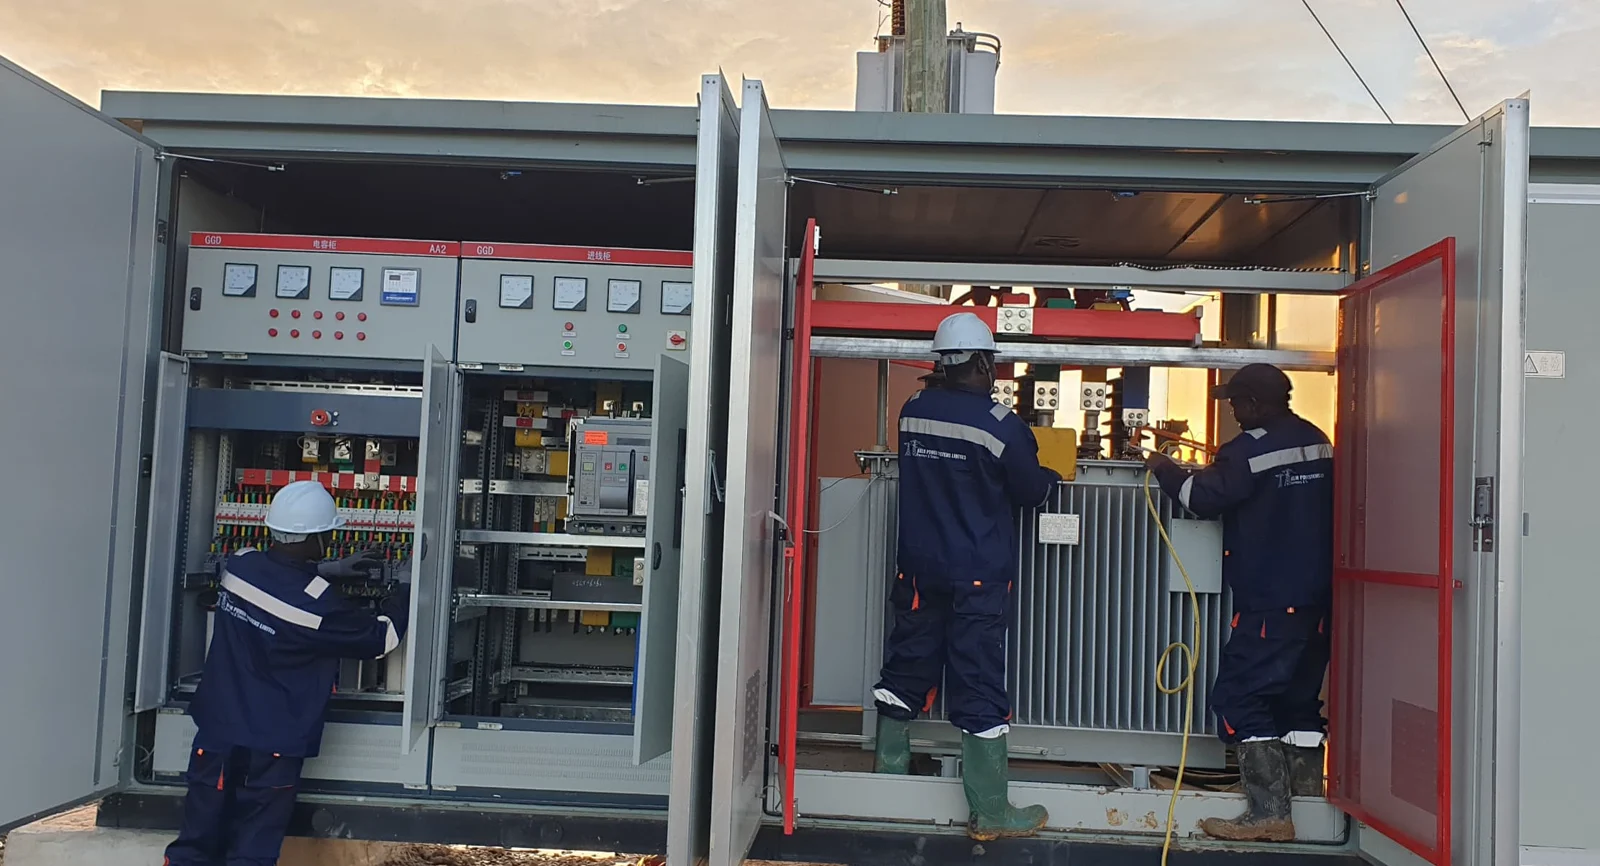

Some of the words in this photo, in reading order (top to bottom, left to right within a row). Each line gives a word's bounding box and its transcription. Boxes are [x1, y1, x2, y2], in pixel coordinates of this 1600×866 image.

[204, 235, 222, 245] GGD
[313, 239, 337, 249] 电容柜
[429, 244, 447, 254] AA2
[476, 245, 494, 255] GGD
[587, 250, 611, 261] 进线柜
[951, 453, 967, 461] LIMITED
[259, 623, 276, 636] LIMITED
